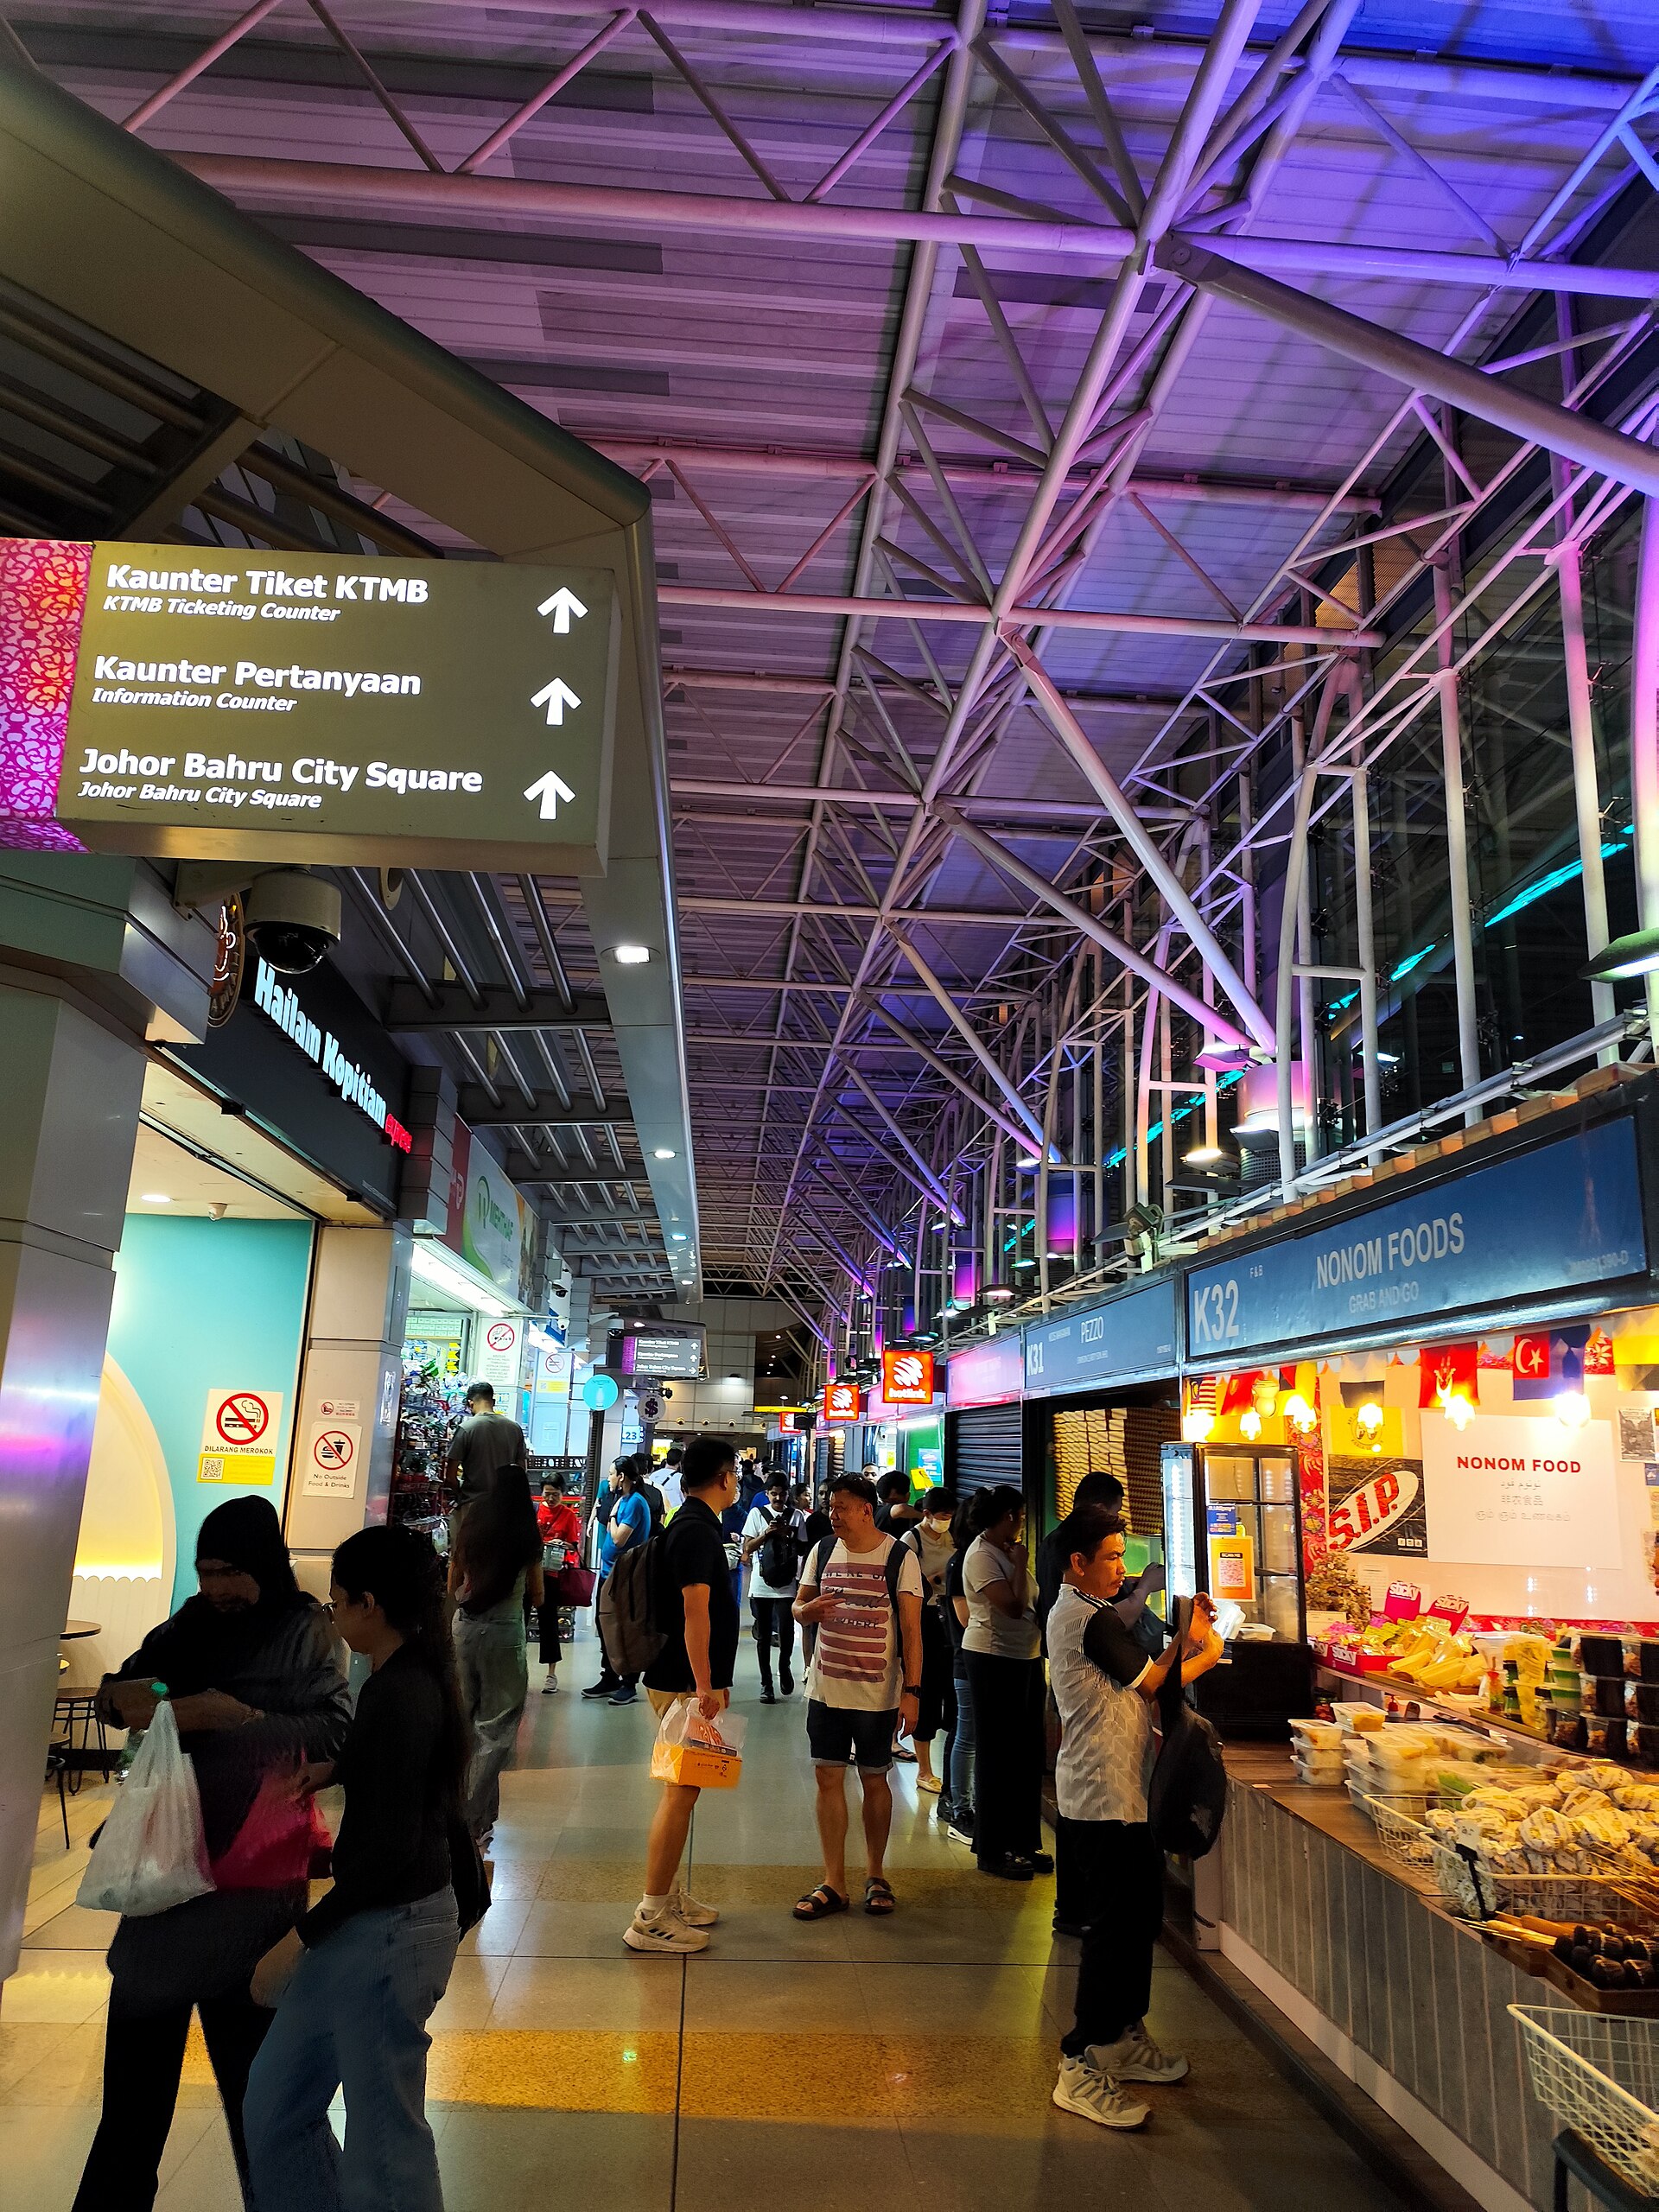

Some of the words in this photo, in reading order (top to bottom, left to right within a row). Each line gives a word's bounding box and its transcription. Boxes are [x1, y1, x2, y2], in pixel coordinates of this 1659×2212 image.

[106, 564, 238, 594] Kaunter
[245, 569, 328, 599] Tiket
[335, 575, 429, 604] KTMB
[103, 595, 162, 614] KTMB
[167, 598, 256, 620] Ticketing
[260, 603, 341, 622] Counter
[94, 655, 227, 685] Kaunter
[234, 661, 422, 697] Pertanyaan
[92, 687, 213, 709] Information
[215, 692, 298, 712] Counter
[79, 748, 175, 777] Johor
[183, 753, 283, 783] Bahru
[291, 758, 359, 792] City
[365, 762, 484, 795] Square
[77, 781, 137, 799] Johor
[139, 784, 200, 803] Bahru
[205, 786, 248, 807] City
[250, 789, 323, 810] Square
[254, 956, 321, 1064] Hailam
[321, 1032, 386, 1130] Kopitiam
[1316, 1237, 1382, 1289] NONOM
[1388, 1212, 1465, 1271] FOODS
[1194, 1279, 1239, 1344] K32
[1348, 1291, 1376, 1314] GRAB
[1378, 1285, 1400, 1307] AND
[1402, 1281, 1420, 1303] GO
[1080, 1315, 1105, 1344] PEZZO
[1027, 1341, 1045, 1376] K31
[888, 1387, 927, 1399] hotlink
[204, 1445, 238, 1453] DILARANG
[239, 1446, 273, 1455] MEROKOK
[1457, 1456, 1525, 1471] NONOM
[1532, 1459, 1581, 1473] FOOD
[1389, 1580, 1421, 1601] sticky
[1434, 1595, 1469, 1614] sticky
